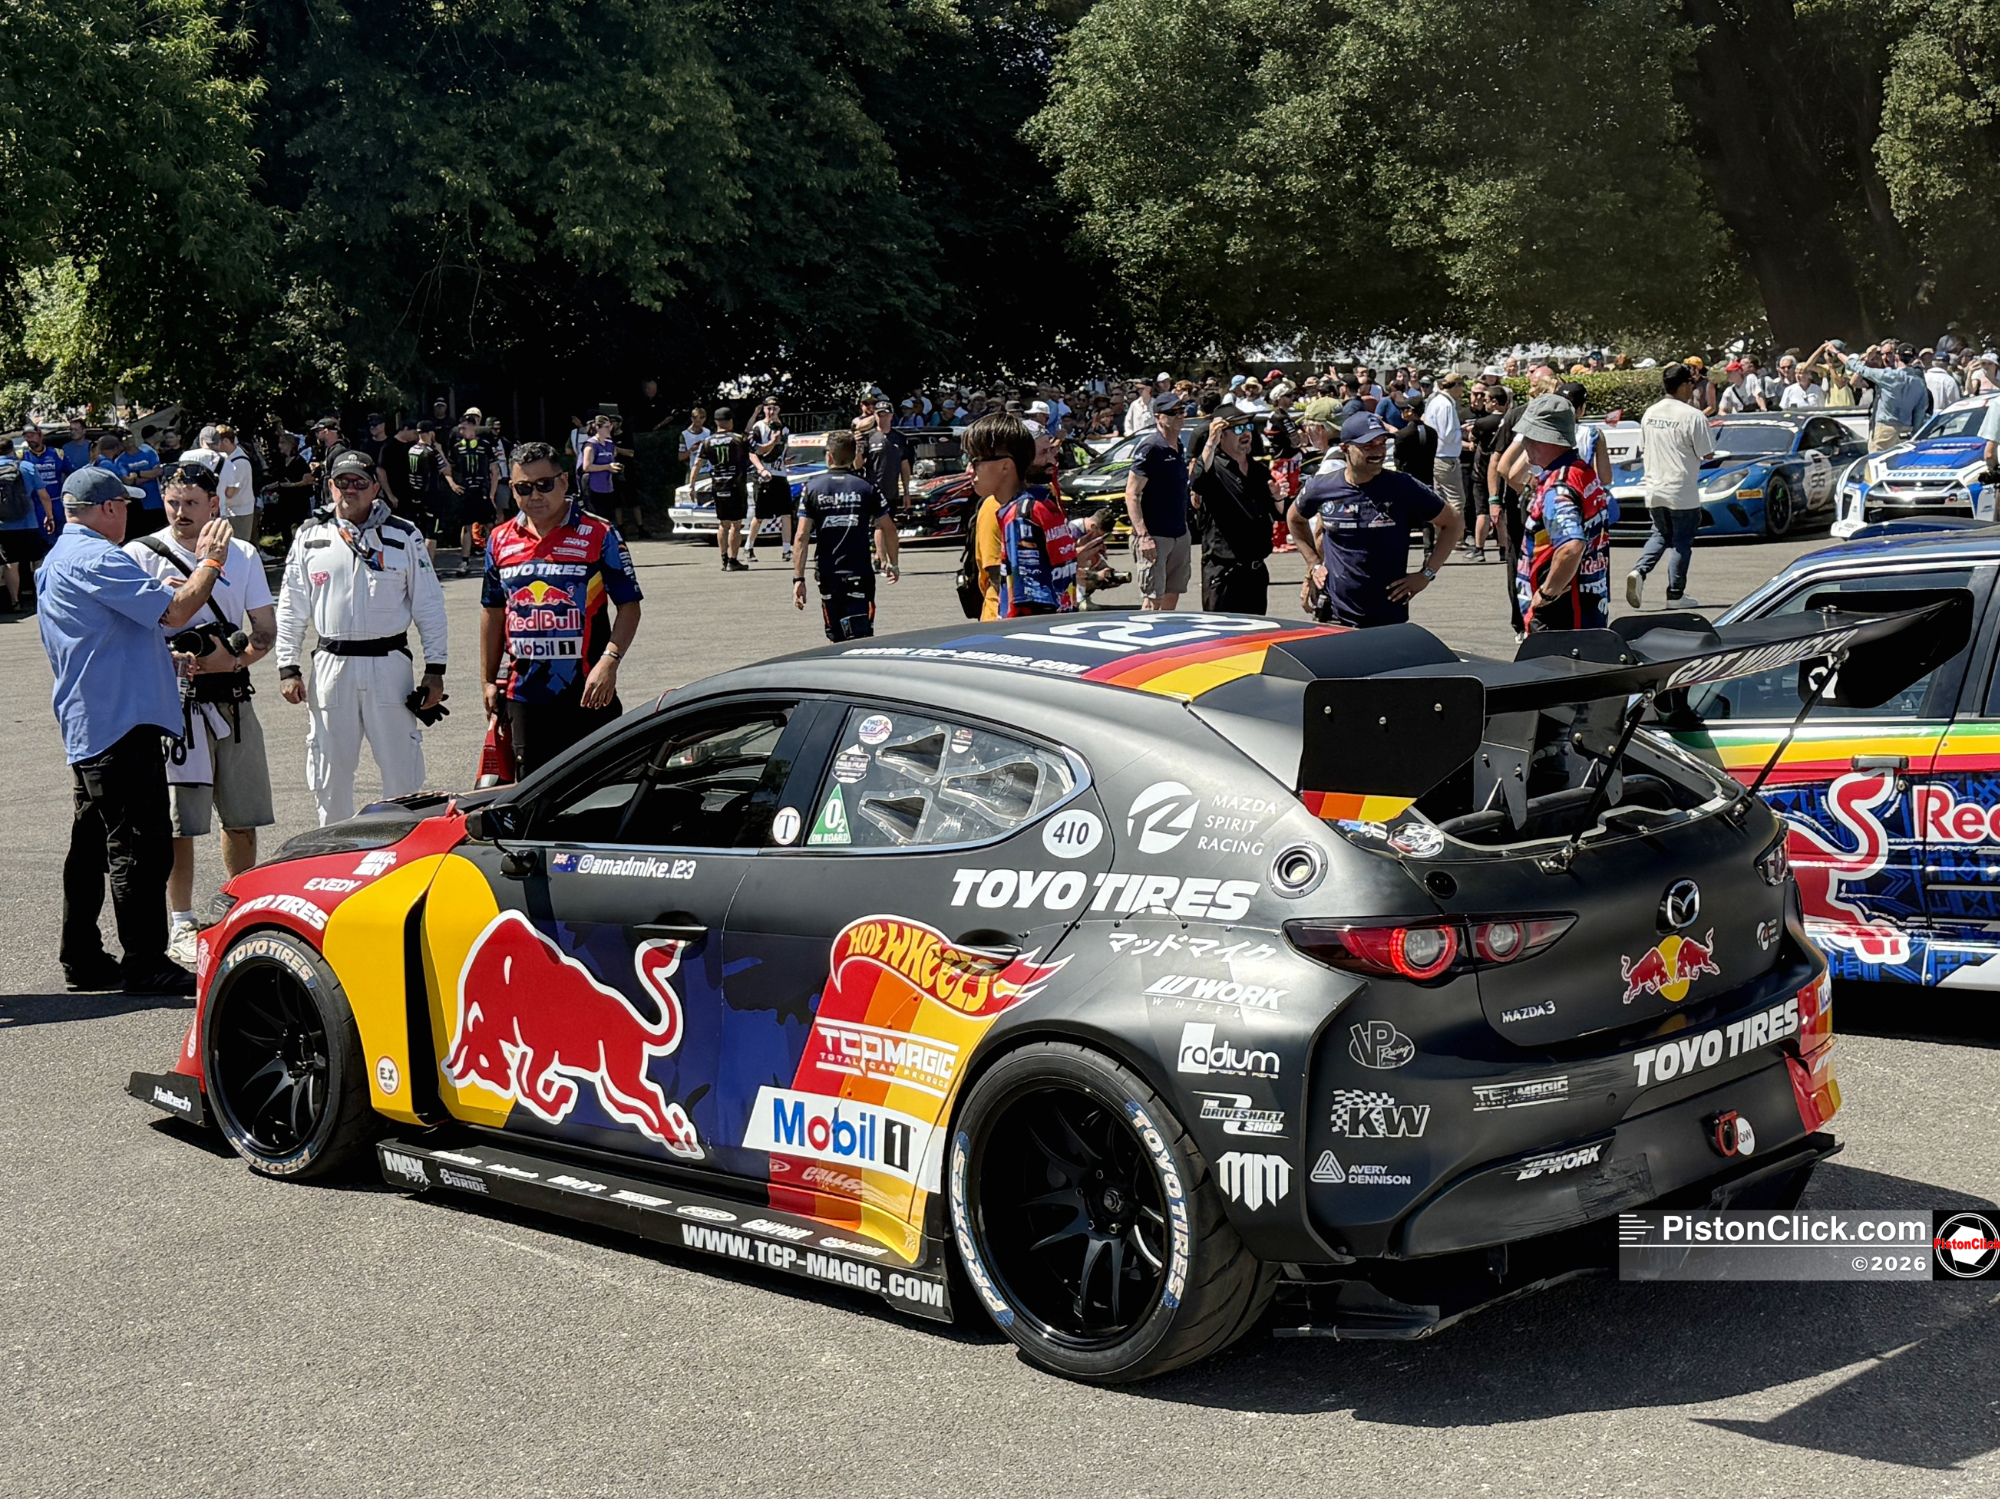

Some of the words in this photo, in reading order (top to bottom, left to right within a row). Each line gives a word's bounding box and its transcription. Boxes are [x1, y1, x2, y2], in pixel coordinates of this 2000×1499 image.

[536, 564, 588, 576] TIRES
[509, 609, 539, 631] Red
[540, 608, 581, 630] Bull
[1004, 613, 1282, 653] 123
[1666, 651, 1743, 689] GOT
[1211, 794, 1276, 815] MAZDA
[1053, 820, 1090, 845] 410
[1205, 815, 1259, 834] SPIRIT
[1197, 836, 1265, 857] RACING
[303, 877, 363, 893] EXEDY
[950, 868, 1088, 911] TOYO
[1090, 872, 1261, 922] TIRES
[268, 894, 330, 931] TIRES
[1108, 932, 1278, 963] マッドマイク
[227, 941, 269, 968] TOYO
[268, 941, 315, 981] TIRES
[1349, 1020, 1396, 1068] VP
[1381, 1045, 1412, 1063] Racing
[1633, 1029, 1723, 1087] TOYO
[1726, 997, 1799, 1058] TIRES
[820, 1052, 859, 1067] TOTAL
[868, 1062, 896, 1073] CAR
[1180, 1040, 1281, 1073] radium
[379, 1066, 396, 1082] EX
[153, 1085, 192, 1113] Haltech
[1203, 1099, 1220, 1109] THE
[1200, 1107, 1285, 1122] DRIVESHAFT
[1244, 1121, 1285, 1134] SHOP
[1345, 1104, 1431, 1138] KW
[773, 1098, 876, 1162] Mobil
[1737, 1129, 1752, 1144] OW
[1349, 1165, 1388, 1175] AVERY
[1548, 1145, 1602, 1174] WORK
[1348, 1174, 1411, 1185] DENNISON
[1132, 1110, 1183, 1199] TOYO
[1167, 1202, 1189, 1301] TIRES
[952, 1139, 1010, 1313] PROXES
[681, 1223, 944, 1308] WWW.TCP-MAGIC.COM
